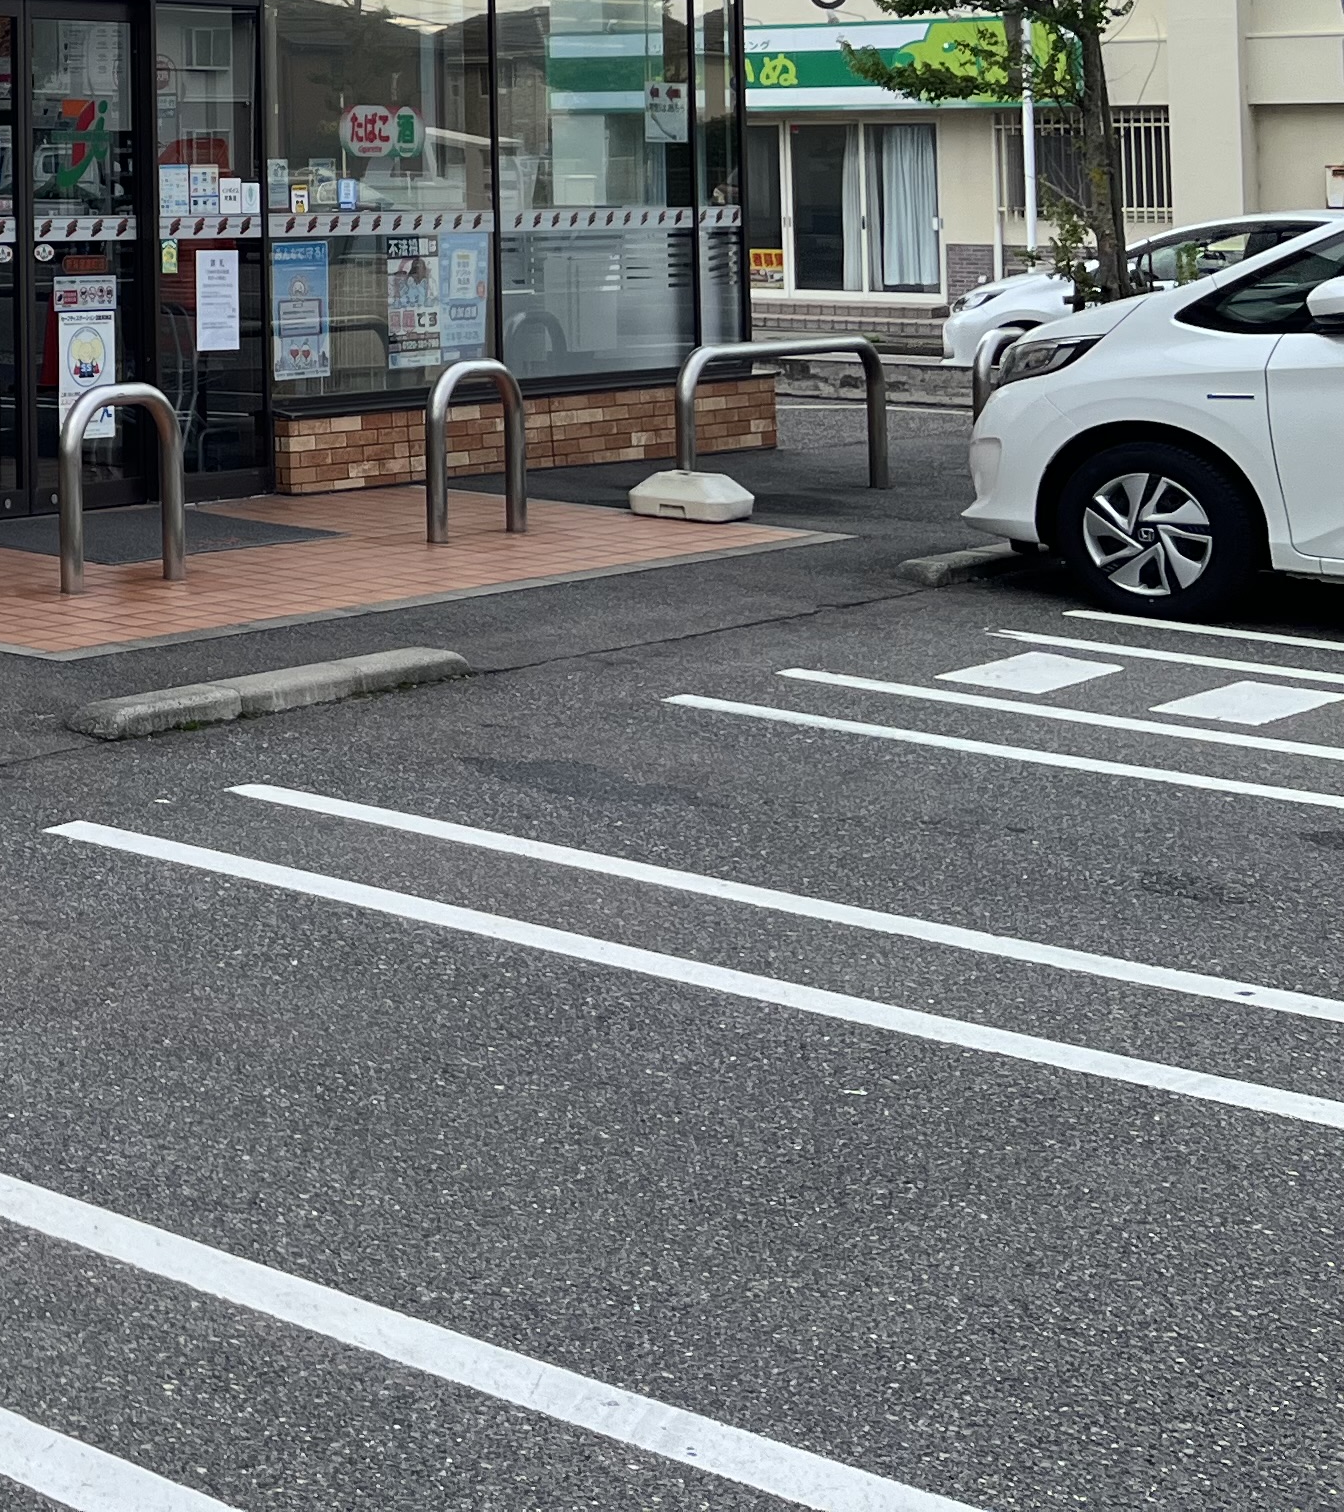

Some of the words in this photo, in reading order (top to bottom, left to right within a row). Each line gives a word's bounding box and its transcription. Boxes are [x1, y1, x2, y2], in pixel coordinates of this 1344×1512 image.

[350, 111, 391, 144] たばこ
[397, 113, 415, 144] 酒
